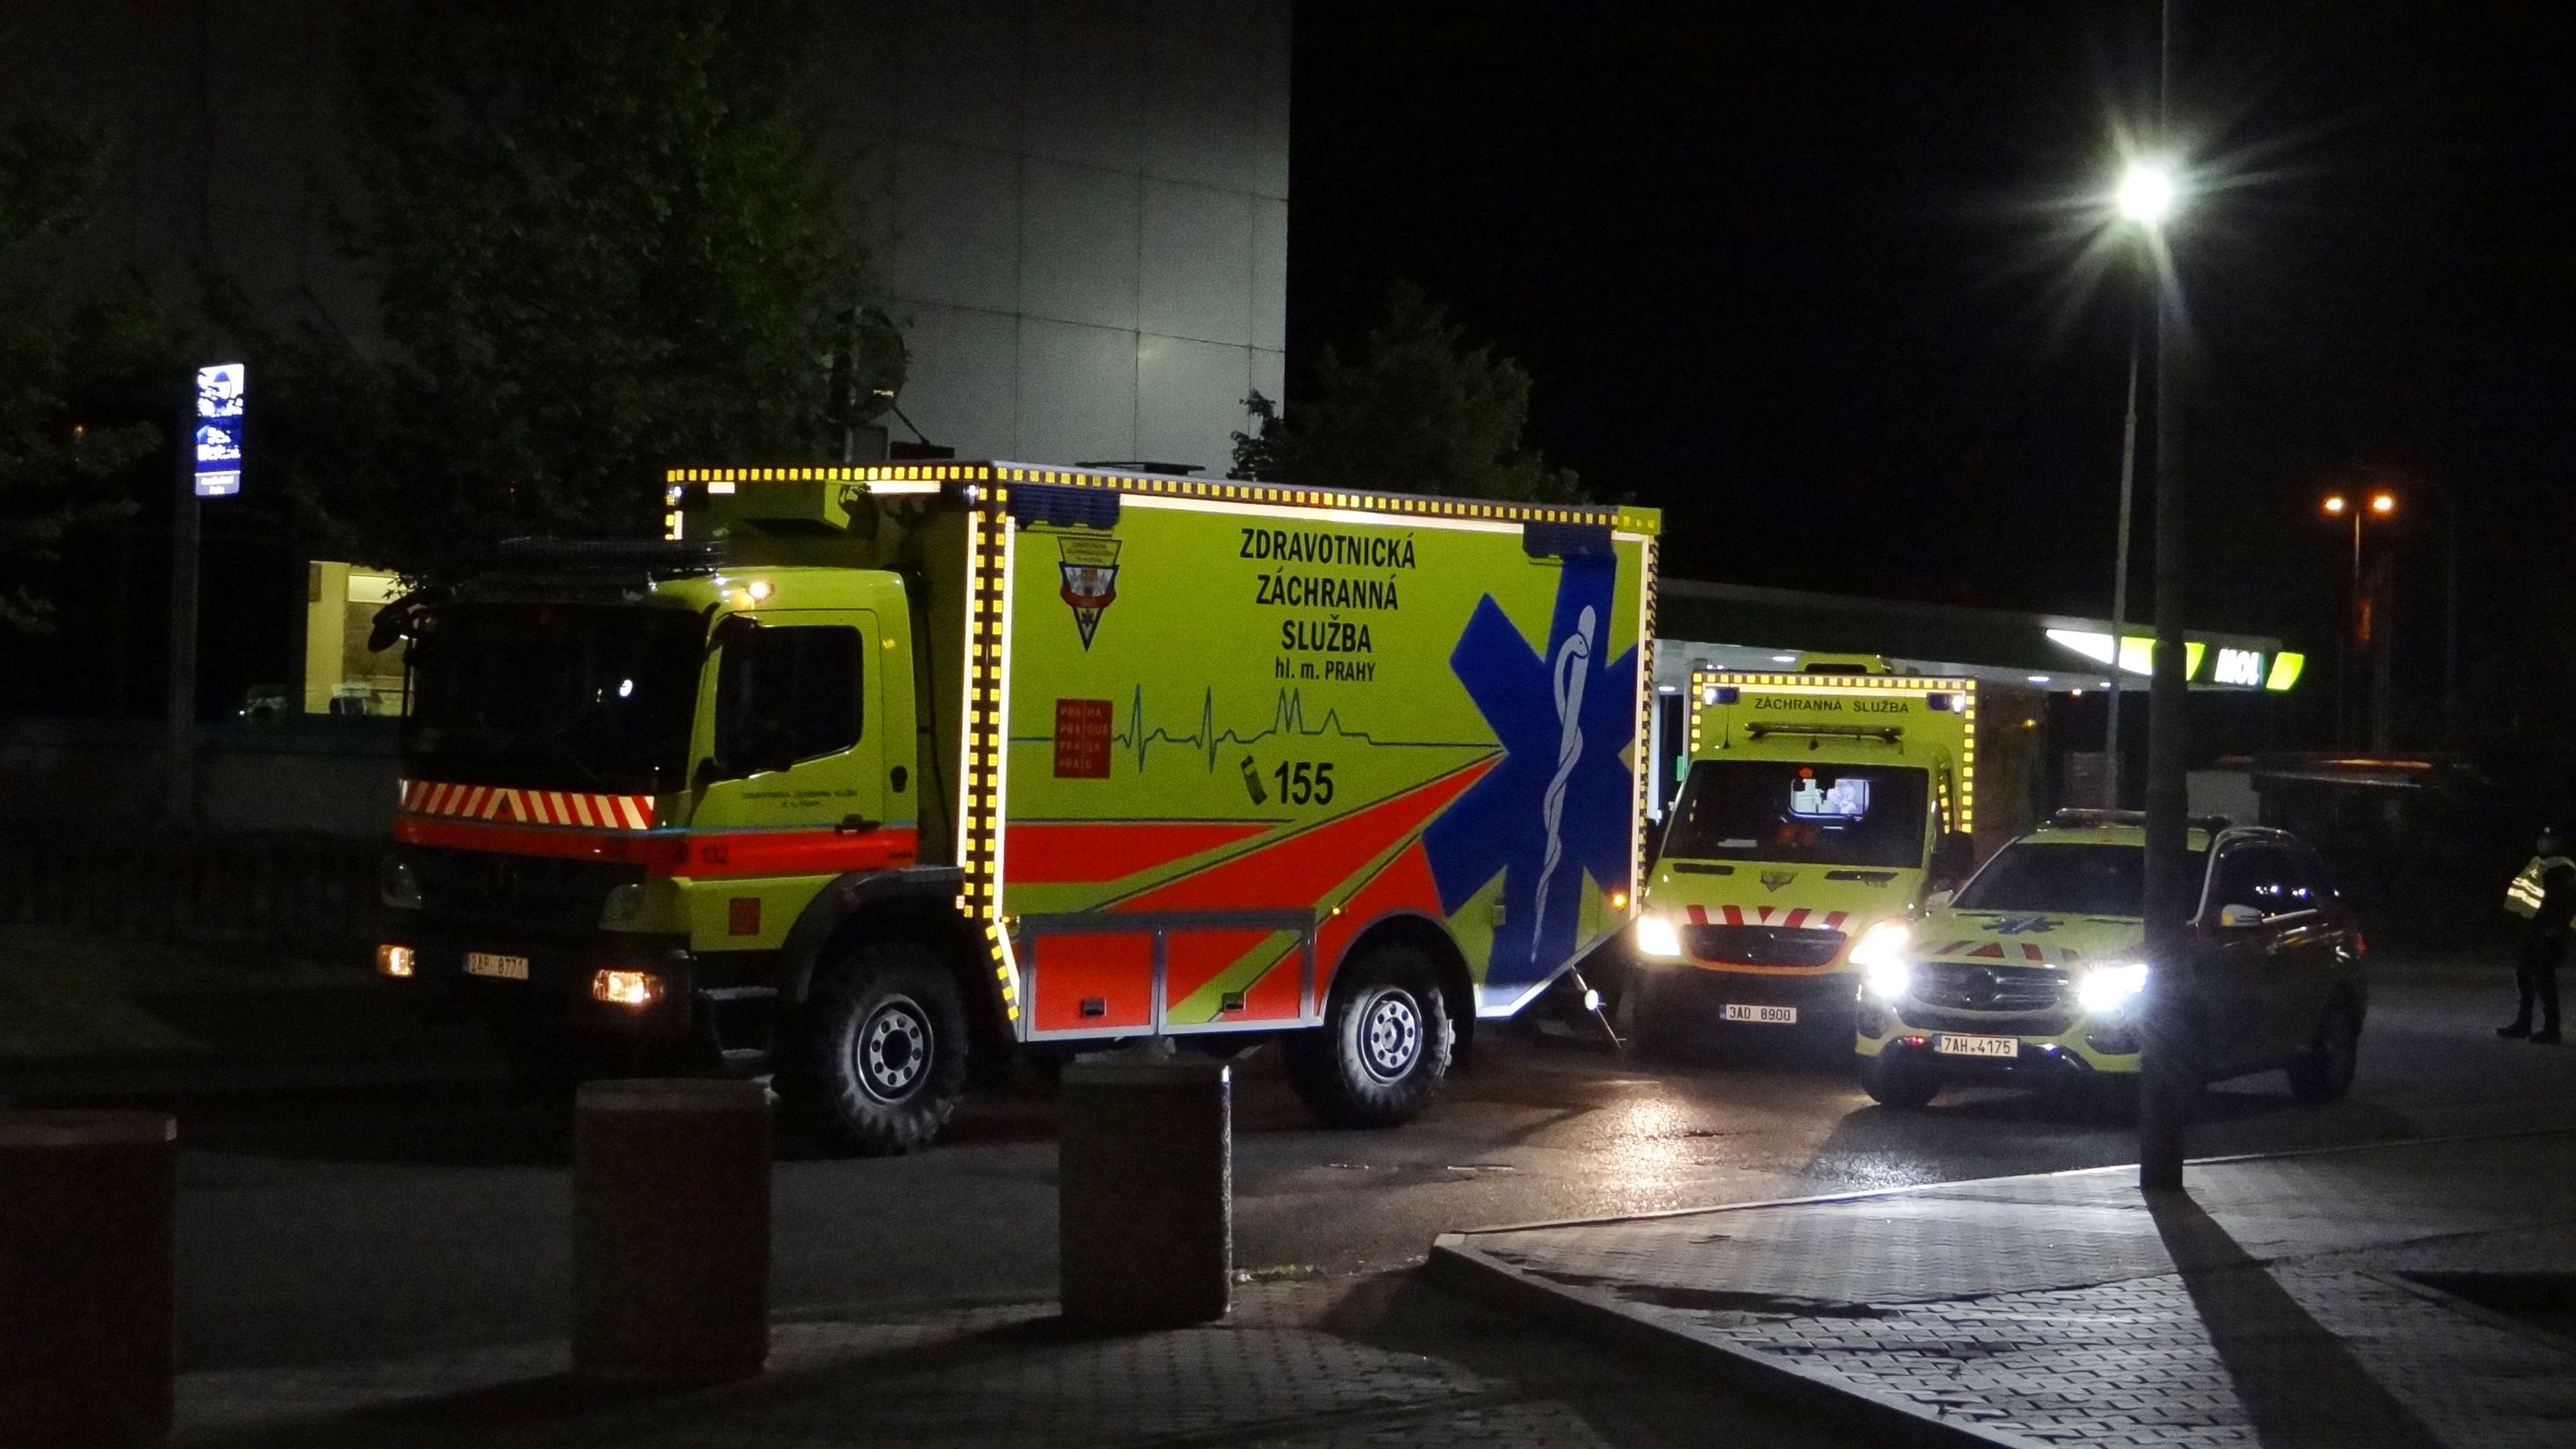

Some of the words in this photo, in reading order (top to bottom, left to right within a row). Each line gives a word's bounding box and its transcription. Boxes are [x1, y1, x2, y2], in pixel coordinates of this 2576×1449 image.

[1239, 528, 1416, 569] ZDRAVOTNICKÁ
[1255, 567, 1399, 611] ZÁCHRANNÁ
[1281, 614, 1372, 654] SLUŽBA
[1275, 656, 1295, 680] hl.
[1300, 663, 1320, 680] m.
[1325, 660, 1377, 682] PRAHY
[1754, 696, 1842, 712] ZÁCHRANNÁ
[1853, 700, 1910, 714] SLUŽBA
[1274, 760, 1334, 805] 155
[1760, 1008, 1791, 1022] 8900
[1977, 1039, 2011, 1054] 4175
